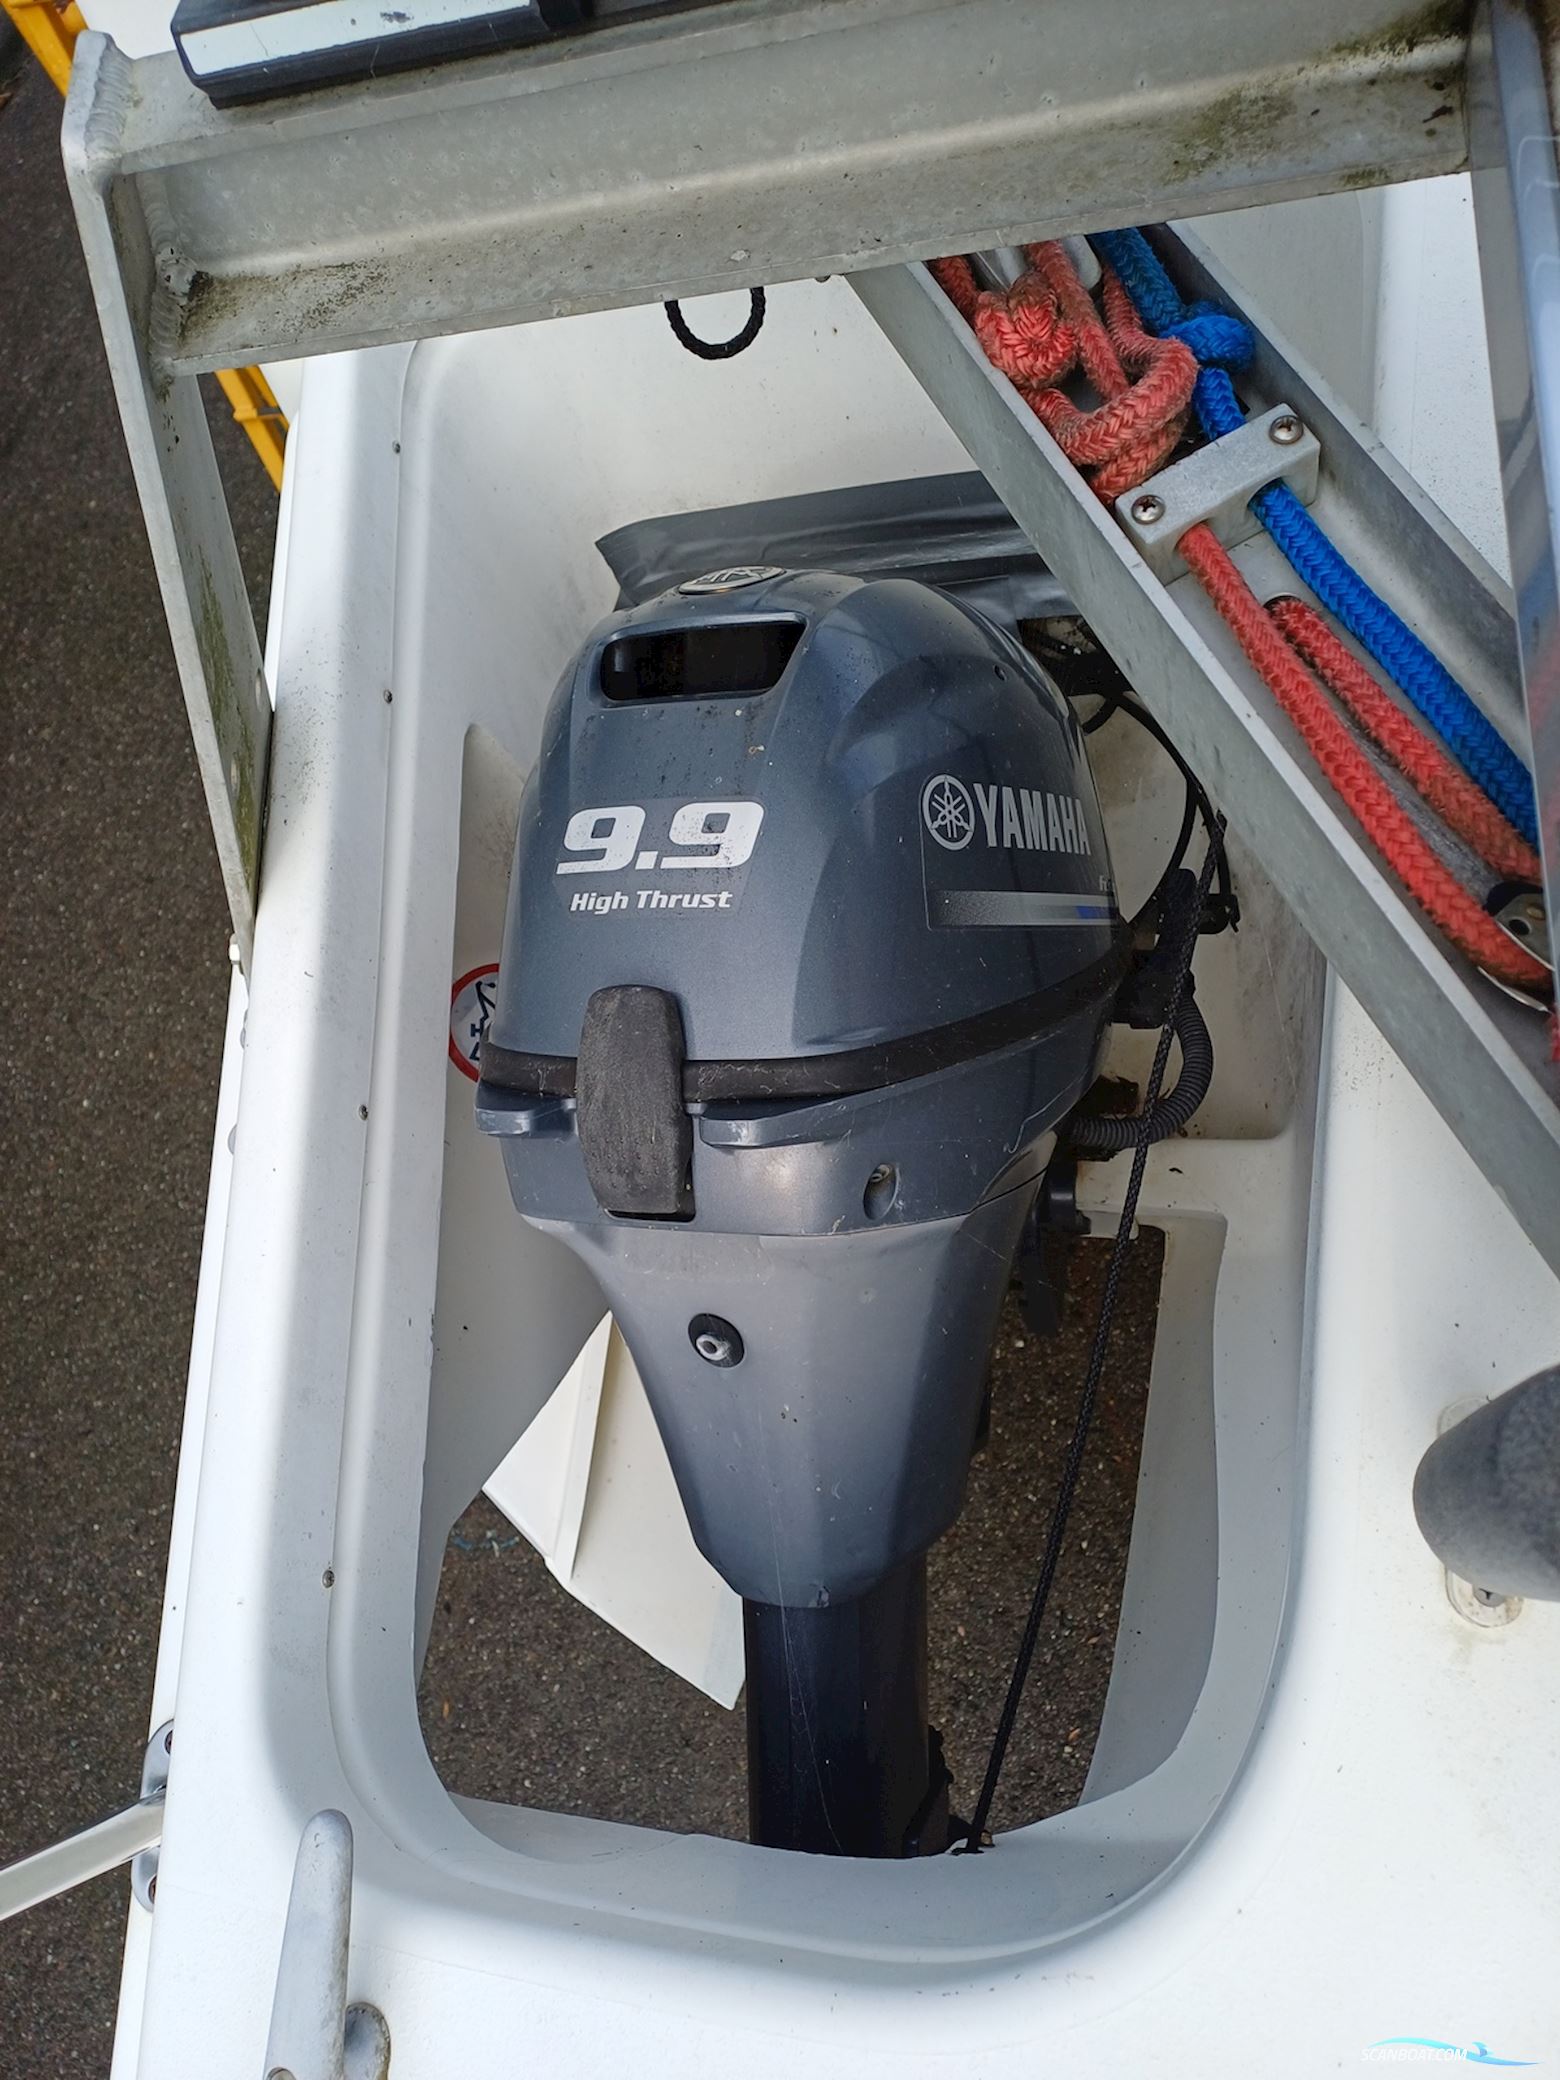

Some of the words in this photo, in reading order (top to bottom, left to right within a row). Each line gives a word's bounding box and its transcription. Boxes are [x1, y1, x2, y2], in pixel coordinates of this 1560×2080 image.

[556, 801, 764, 875] 9.9
[973, 783, 1091, 855] YAMAHA
[570, 892, 629, 915] High
[637, 890, 733, 909] Thrust
